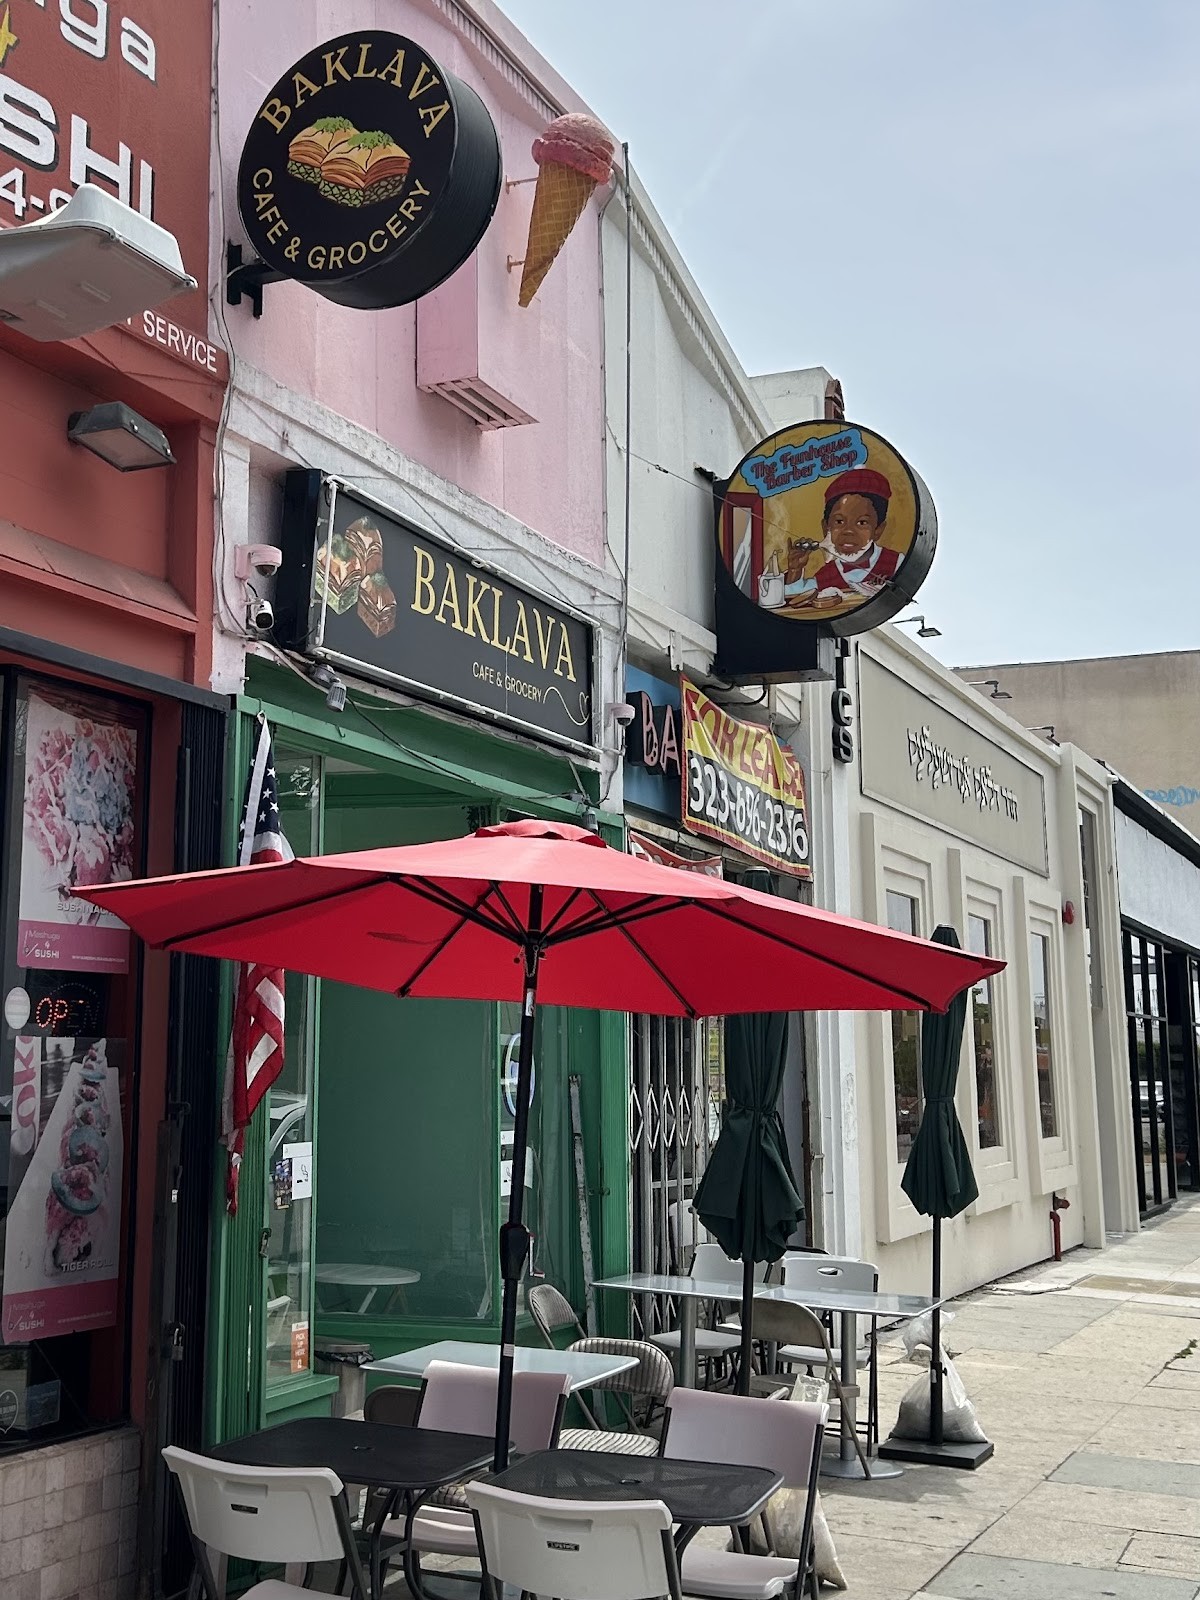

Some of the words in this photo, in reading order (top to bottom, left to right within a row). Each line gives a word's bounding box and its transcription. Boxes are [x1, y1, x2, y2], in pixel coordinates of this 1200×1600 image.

[28, 0, 155, 81] ga
[258, 43, 451, 138] BAKLAVA
[252, 167, 289, 244] CAFE
[284, 236, 301, 262] &
[307, 179, 432, 270] GROCERY
[143, 310, 217, 373] SERVICE
[751, 460, 778, 479] The
[780, 436, 853, 469] Funhouse
[763, 463, 816, 490] Barber
[820, 449, 858, 471] Shop
[411, 545, 577, 683] BAKLAVA
[472, 661, 494, 685] CAFE
[496, 671, 503, 688] &
[505, 674, 542, 703] GROCERY
[34, 949, 60, 959] SUSHI
[61, 1261, 89, 1272] TIGER
[19, 1318, 45, 1331] SUSHI
